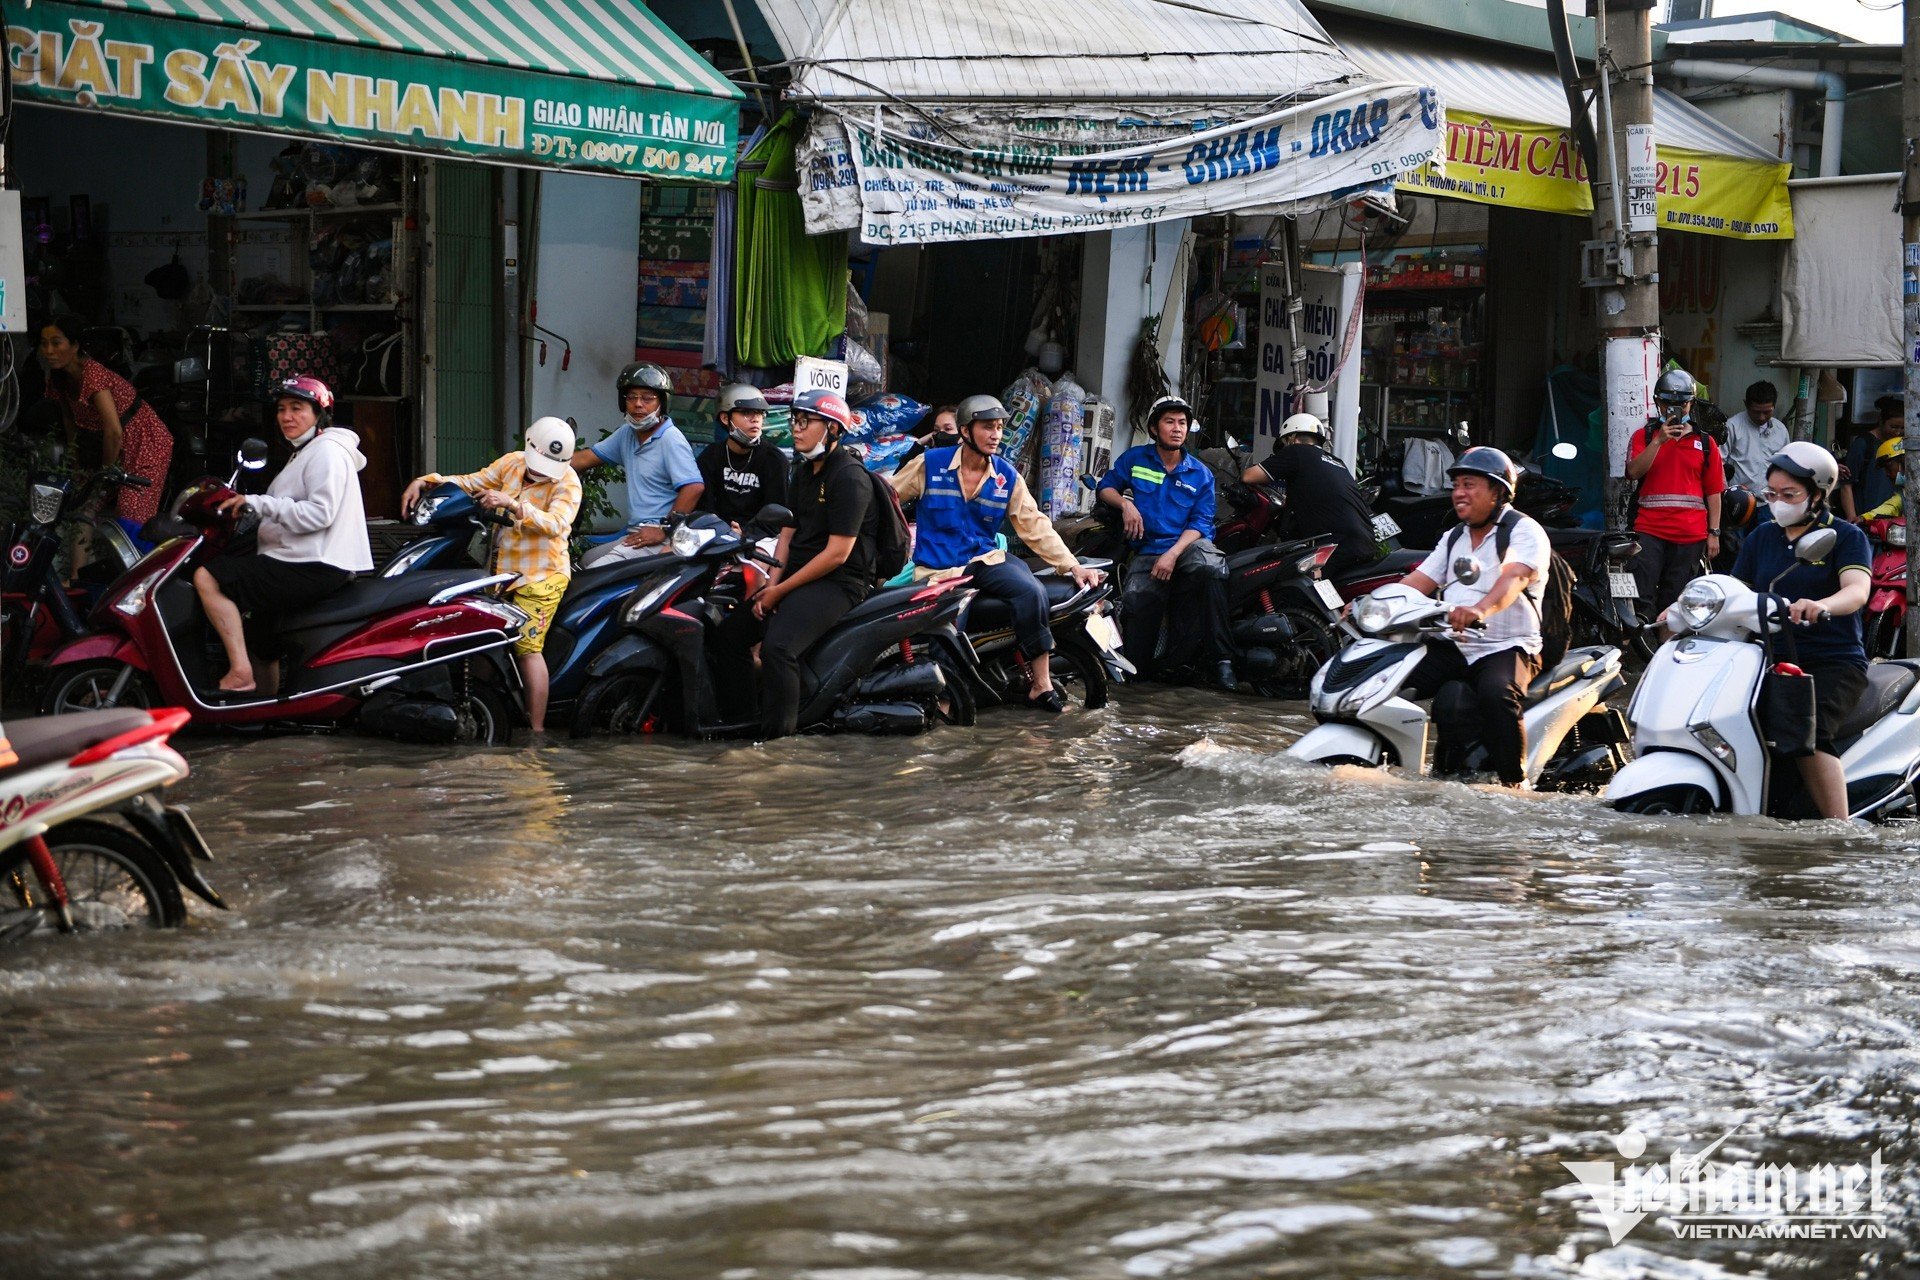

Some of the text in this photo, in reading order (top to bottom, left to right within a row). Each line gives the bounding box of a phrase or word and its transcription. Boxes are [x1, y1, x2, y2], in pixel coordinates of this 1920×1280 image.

[6, 18, 526, 150] GIẶT SẤY NHANH
[533, 98, 726, 145] GIAO NHẬN TẬN NƠI
[531, 133, 727, 176] ĐT: 0907 500 247
[1446, 119, 1523, 176] TIỆM
[1371, 160, 1397, 175] ĐT:
[1655, 161, 1701, 199] 215
[899, 222, 926, 238] 215
[1262, 342, 1284, 375] GA
[810, 369, 840, 389] VÕNG
